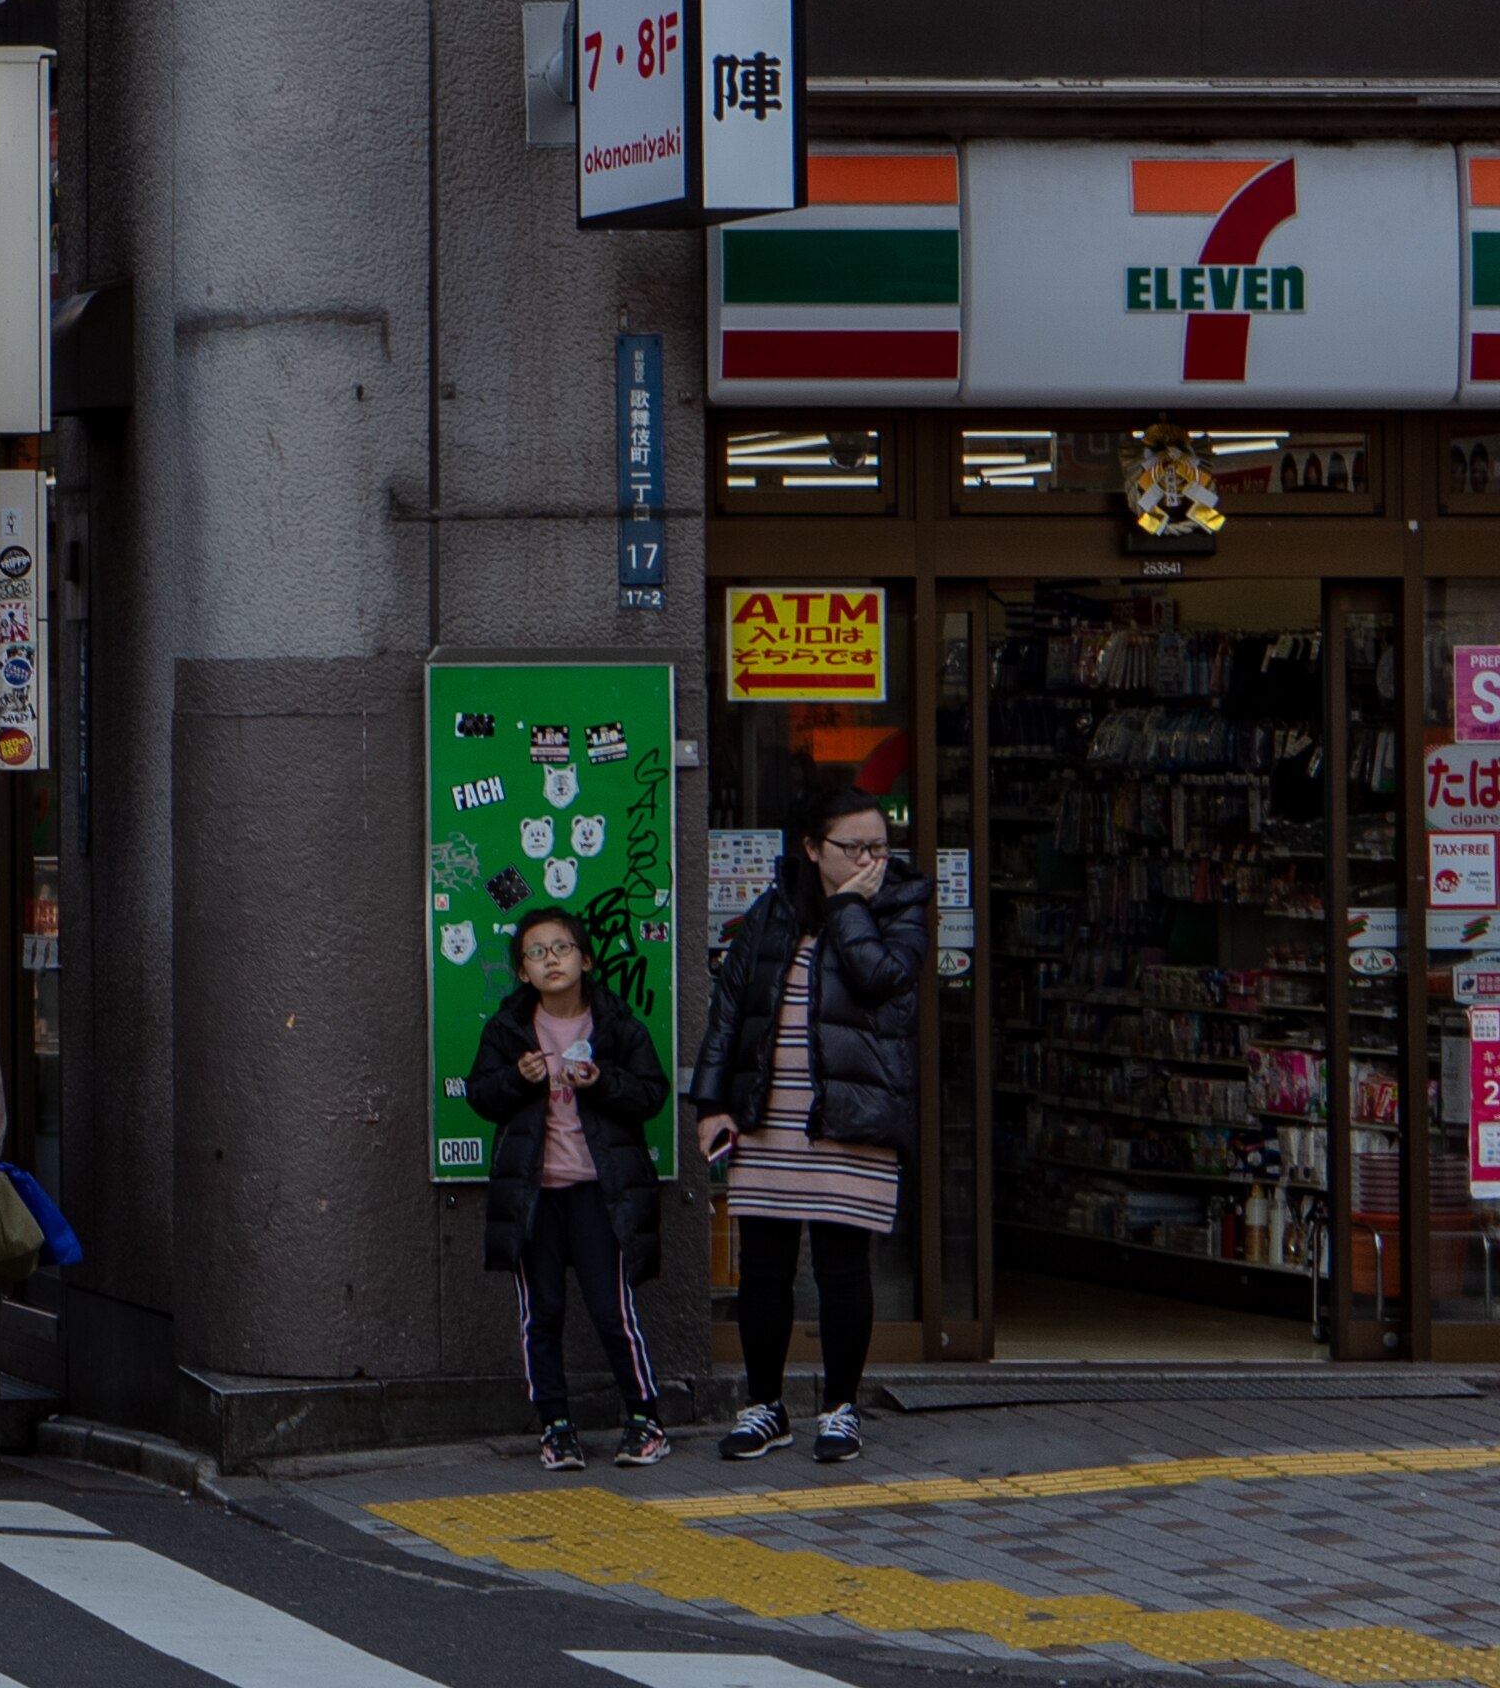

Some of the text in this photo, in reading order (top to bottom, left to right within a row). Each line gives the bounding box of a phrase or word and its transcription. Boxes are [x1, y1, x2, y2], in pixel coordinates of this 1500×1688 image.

[583, 124, 682, 178] okonomiyaki
[630, 389, 652, 525] 歌舞伎町一丁目
[626, 542, 658, 570] 17
[626, 589, 662, 606] 17-2
[733, 593, 879, 625] ATM
[748, 625, 864, 645] 入り口は
[732, 647, 880, 667] そちらです
[536, 731, 565, 746] LEO
[452, 775, 504, 811] FACH
[441, 1140, 480, 1163] CROD
